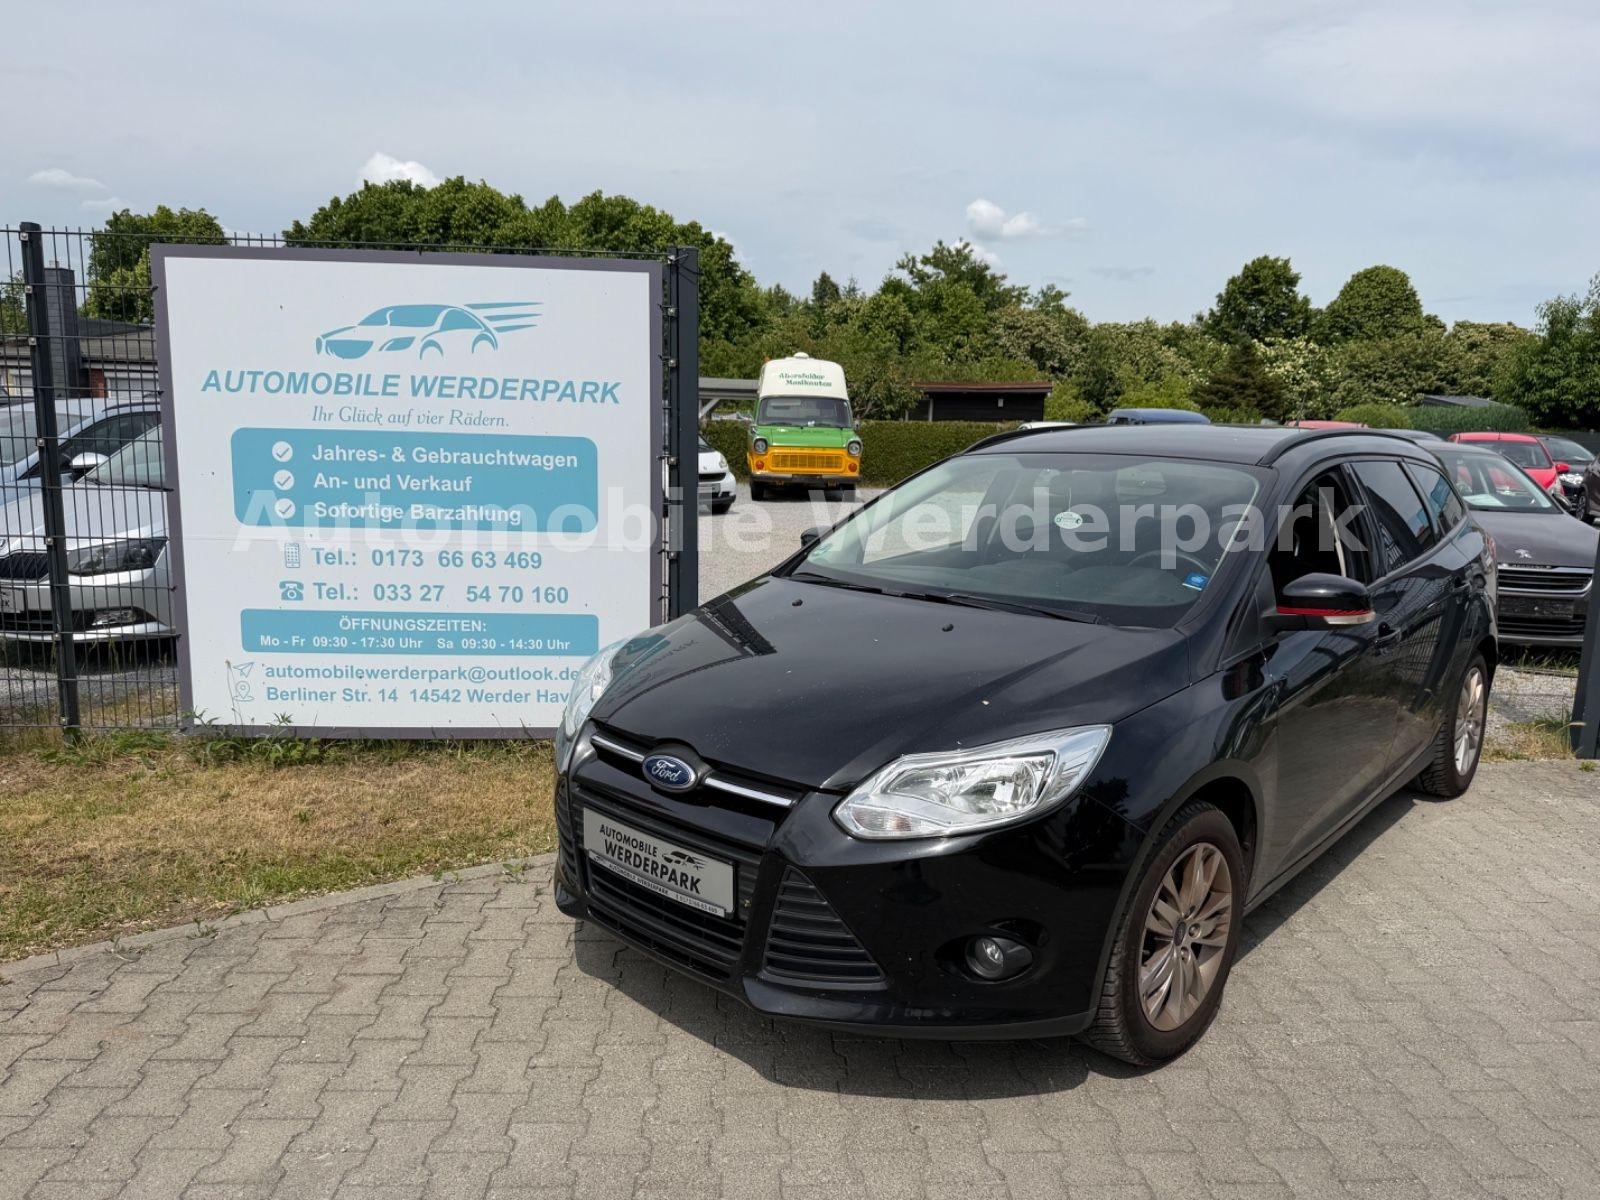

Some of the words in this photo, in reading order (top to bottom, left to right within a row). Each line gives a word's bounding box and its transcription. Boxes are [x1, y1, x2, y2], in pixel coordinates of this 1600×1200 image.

[201, 370, 400, 397] AUTOMOBILE
[410, 375, 621, 404] WERDERPARK
[312, 405, 334, 422] Ihr
[338, 406, 383, 426] Glück
[387, 408, 413, 426] auf
[417, 410, 445, 425] vier
[448, 409, 509, 428] Rädern.
[312, 445, 386, 463] Jahres-
[391, 447, 406, 463] &
[412, 447, 578, 471] Gebrauchtwagen
[313, 473, 348, 489] An-
[354, 474, 391, 490] und
[396, 475, 473, 492] Verkauf
[314, 502, 404, 523] Sofortige
[410, 503, 522, 525] Barzahlung
[311, 548, 357, 566] Tel.:
[371, 549, 424, 568] 0173
[437, 551, 464, 568] 66
[471, 551, 497, 568] 63
[503, 552, 542, 569] 469
[312, 582, 358, 601] Tel.:
[373, 584, 412, 602] 033
[419, 584, 445, 602] 27
[466, 585, 492, 603] 54
[498, 585, 524, 604] 70
[531, 586, 569, 604] 160
[339, 616, 487, 632] ÖFFNUNGSZEITEN:
[260, 635, 280, 647] Mo
[292, 636, 306, 647] Fr
[312, 636, 348, 648] 09:30
[360, 637, 395, 649] 17:30
[399, 638, 423, 649] Uhr
[437, 638, 454, 649] Sa
[461, 638, 497, 650] 09:30
[509, 639, 543, 650] 14:30
[546, 640, 571, 650] Uhr
[265, 664, 579, 684] automobilewerderpark@outlook.de
[266, 687, 337, 702] Berliner
[342, 688, 372, 702] Str.
[378, 688, 399, 702] 14
[409, 688, 461, 703] 14542
[466, 689, 531, 703] Werder
[650, 759, 682, 783] Ford
[599, 823, 658, 858] AUTOMOBILE
[604, 839, 701, 895] WERDERPARK
